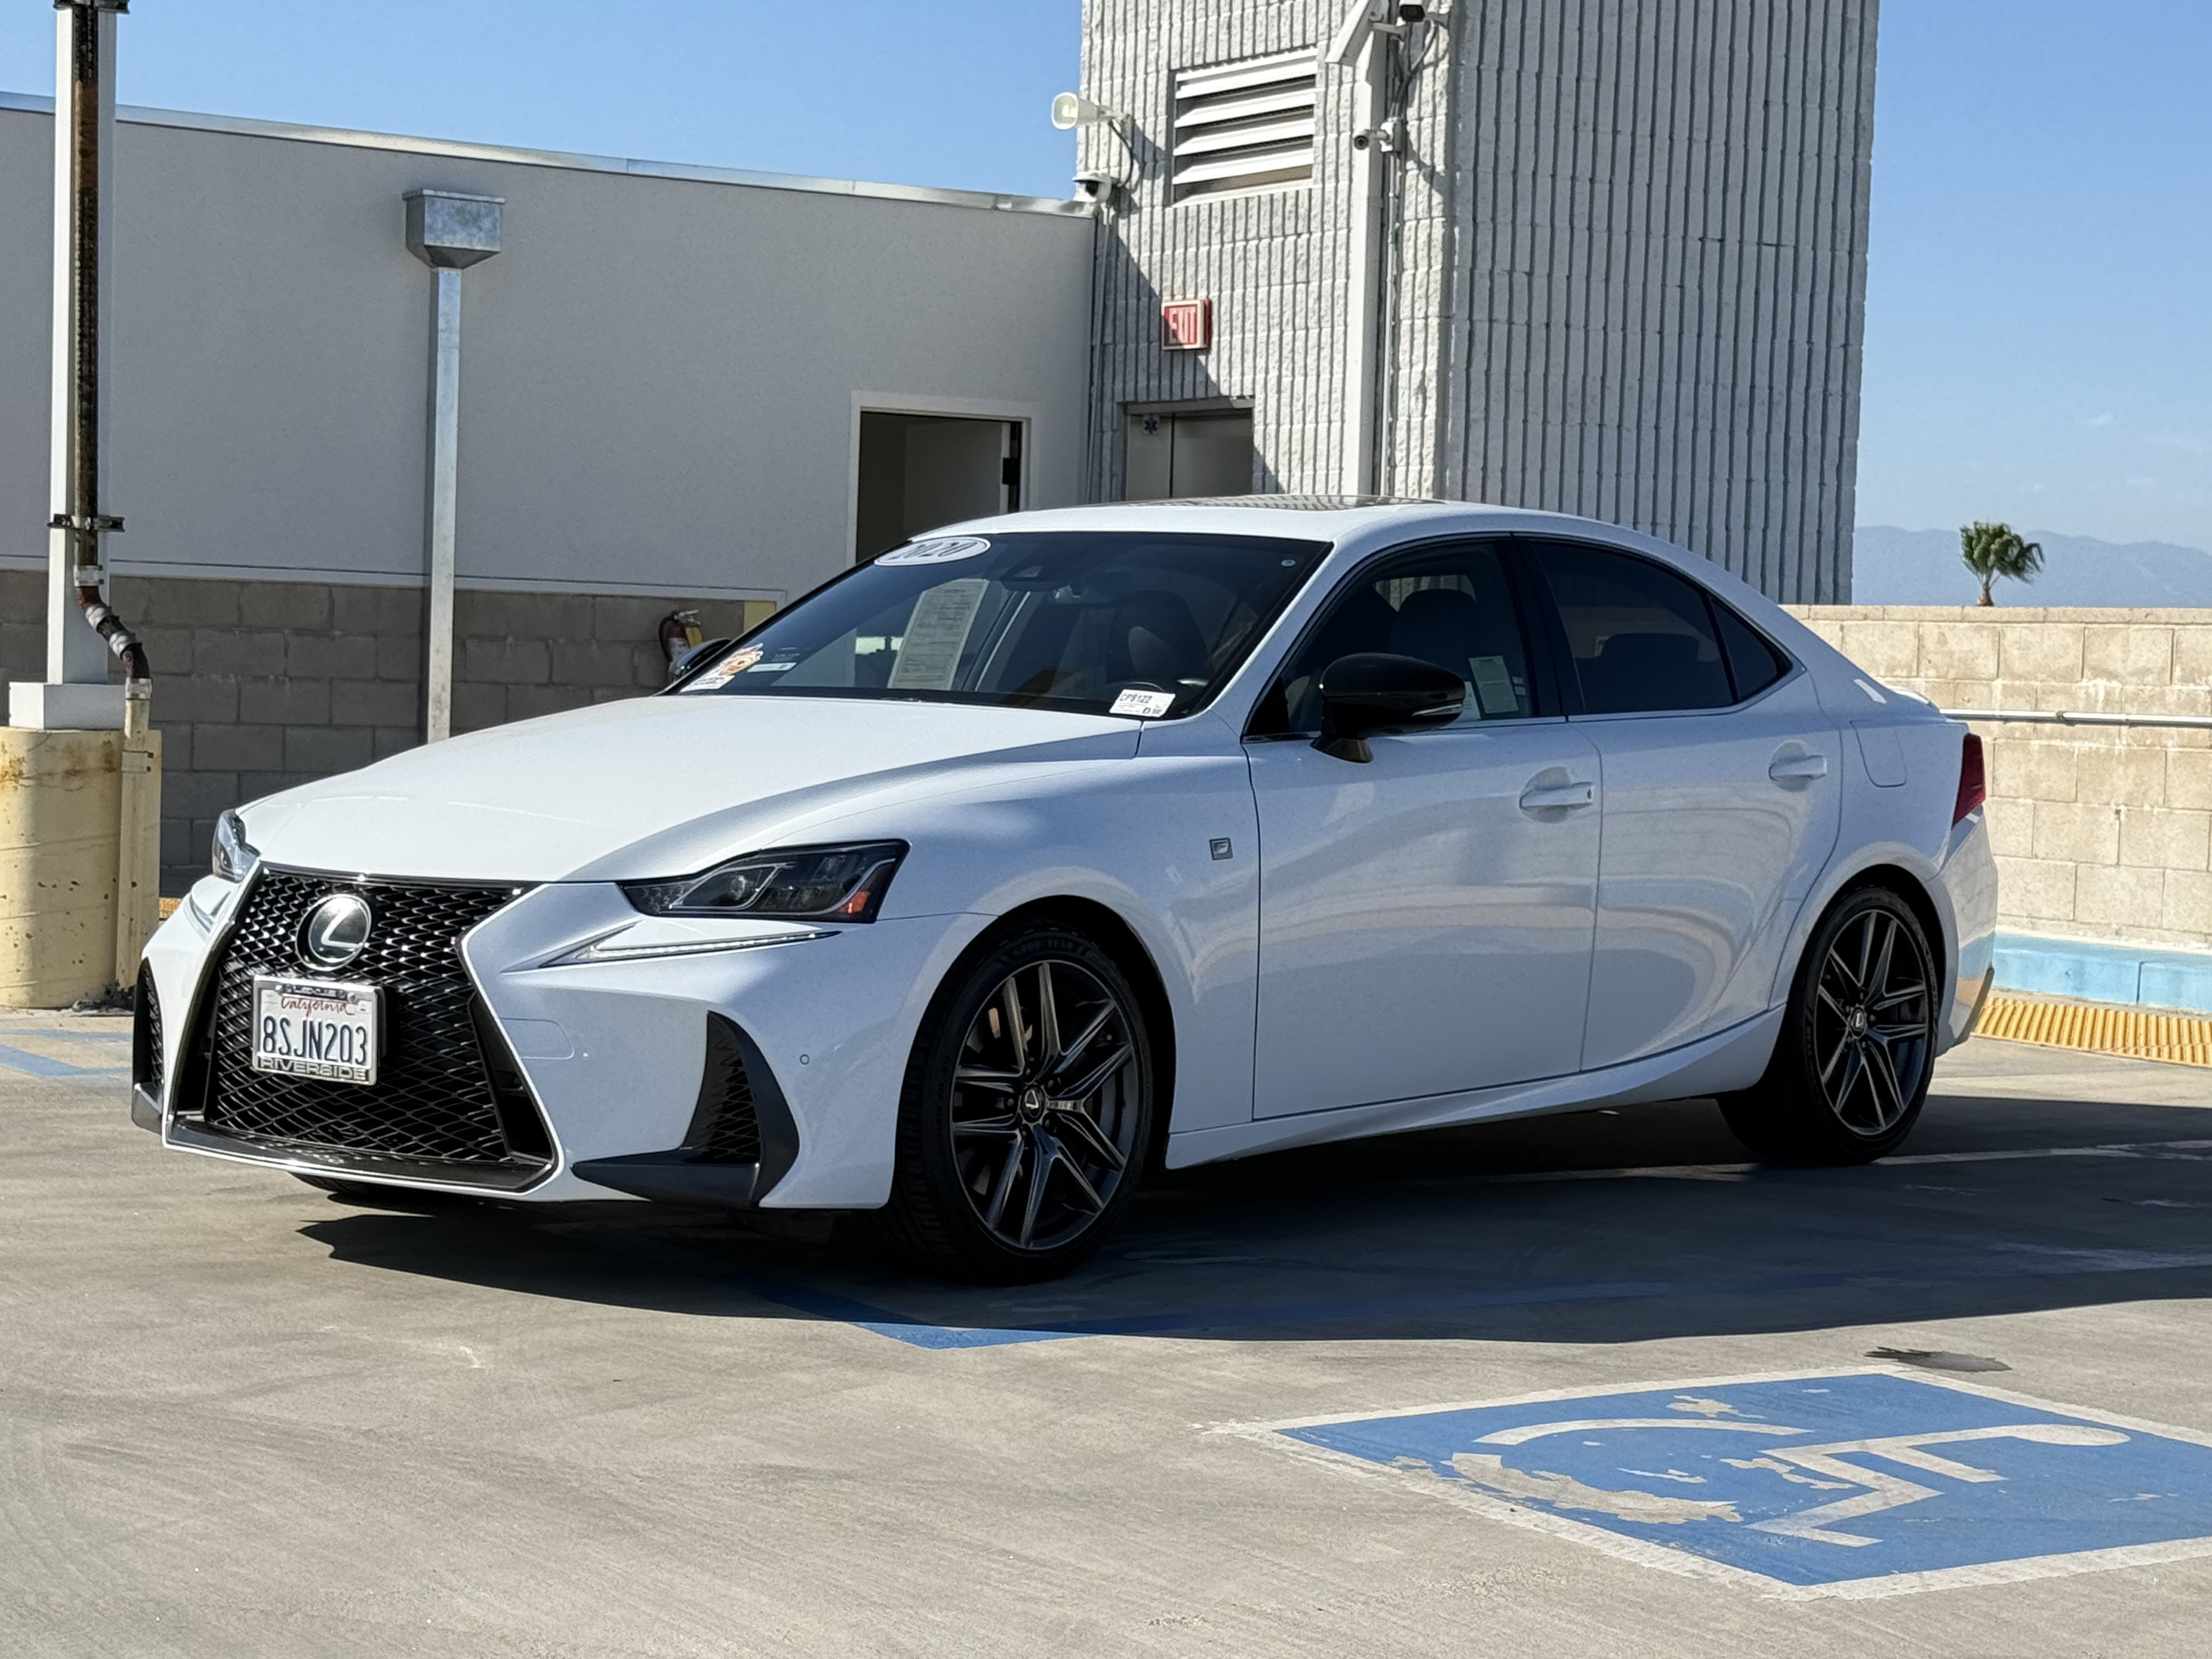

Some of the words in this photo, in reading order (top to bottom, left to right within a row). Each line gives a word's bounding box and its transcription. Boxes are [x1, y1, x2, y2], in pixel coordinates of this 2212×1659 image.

[1169, 307, 1195, 344] EXIT
[884, 541, 978, 560] 2020
[281, 996, 356, 1017] California
[263, 1015, 368, 1066] 8SJN203
[260, 1057, 366, 1081] RIVERSIDE
